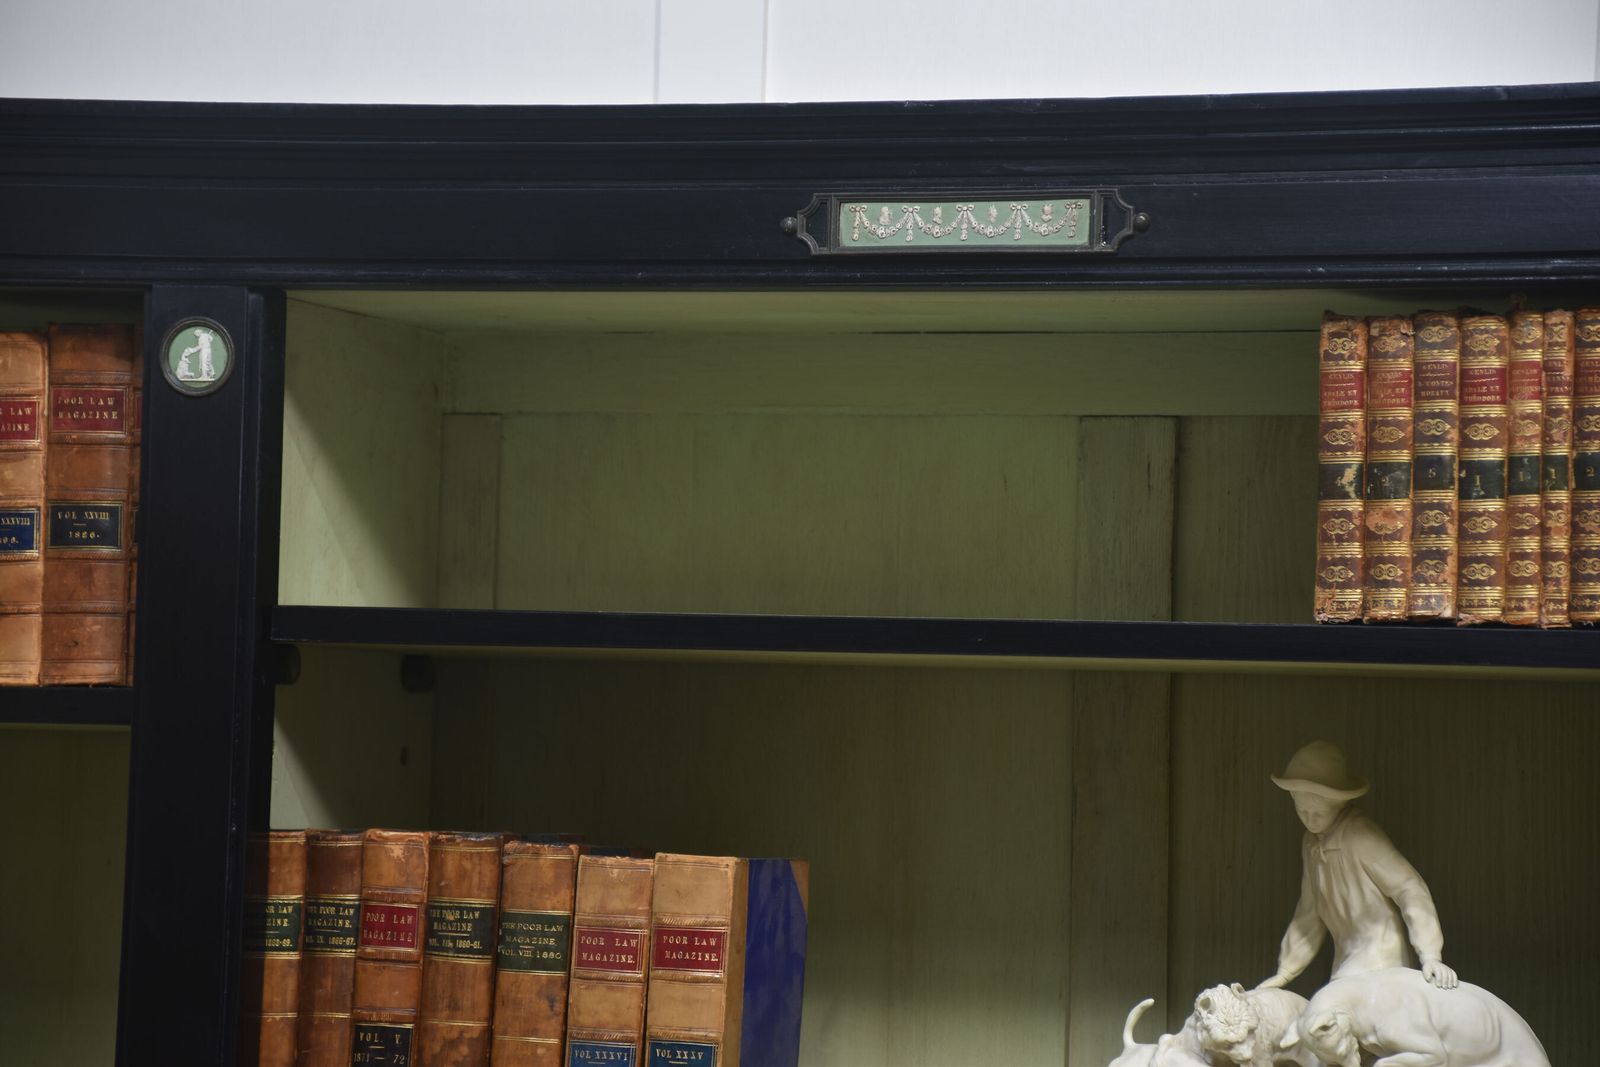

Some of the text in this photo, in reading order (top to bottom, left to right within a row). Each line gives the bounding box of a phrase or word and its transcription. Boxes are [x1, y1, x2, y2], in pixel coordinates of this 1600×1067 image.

[90, 397, 115, 406] LAW
[10, 407, 32, 416] LAW
[278, 906, 294, 914] LAW
[339, 908, 355, 916] LAW
[393, 914, 414, 925] LAW
[463, 911, 481, 920] LAW
[517, 923, 542, 931] POOR
[580, 936, 638, 947] POOR LAW
[663, 936, 717, 946] POOR LAW
[574, 1049, 591, 1059] VOL
[656, 1048, 703, 1060] VOL XXXV
[393, 1054, 406, 1065] 72
